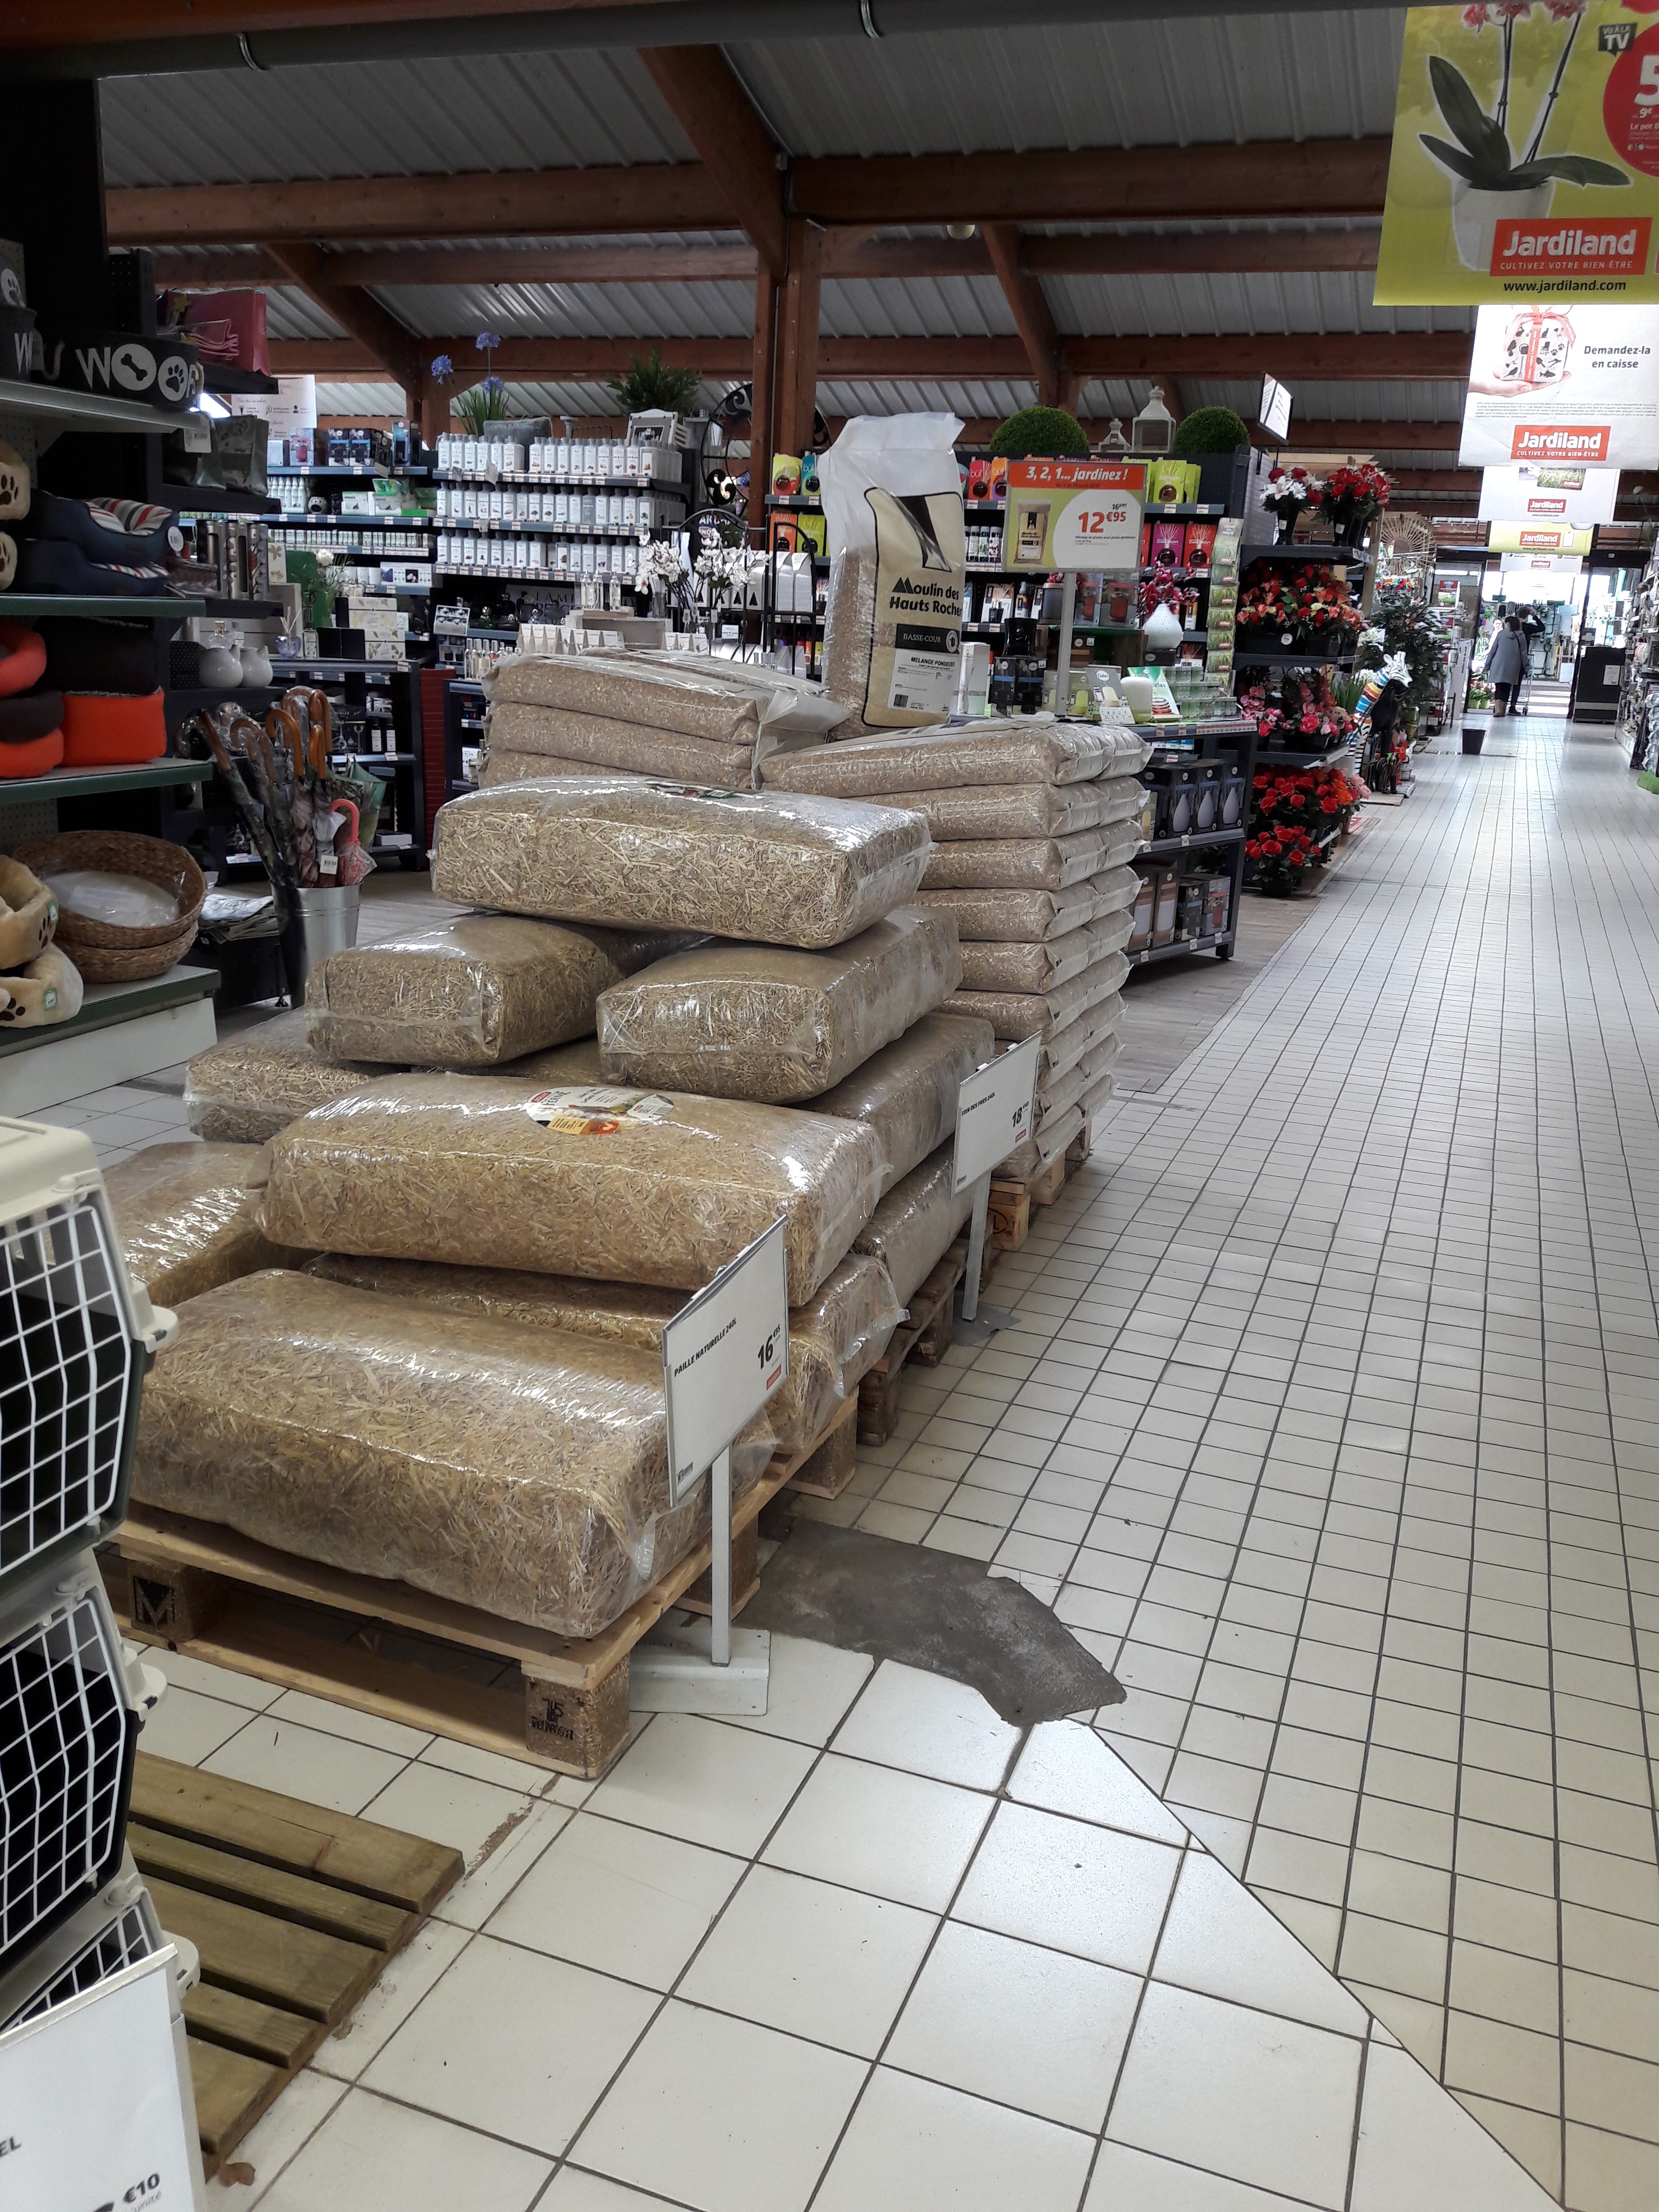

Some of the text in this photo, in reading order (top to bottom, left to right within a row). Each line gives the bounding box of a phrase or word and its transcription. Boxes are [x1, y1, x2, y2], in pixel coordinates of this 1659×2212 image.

[1604, 33, 1630, 50] TV
[1503, 229, 1637, 257] Jardiland
[1500, 260, 1632, 271] CULTIVEZ VOTRE BIEN-ÊTRE
[1504, 280, 1626, 293] www.jardiland.com
[1584, 346, 1651, 355] Demandez-la
[1592, 359, 1639, 369] en caisse
[1518, 431, 1602, 450] Jardiland
[1026, 466, 1129, 482] 3, 2, 1... jardinez !
[1530, 500, 1564, 509] Jardiland
[1522, 534, 1558, 543] Jardiland
[892, 577, 959, 601] Moulin des
[889, 596, 930, 612] Hauts
[903, 633, 941, 644] BASSE-COUR
[911, 657, 934, 665] MELANGE
[674, 1317, 737, 1378] PAILLE NATURELLE 240L
